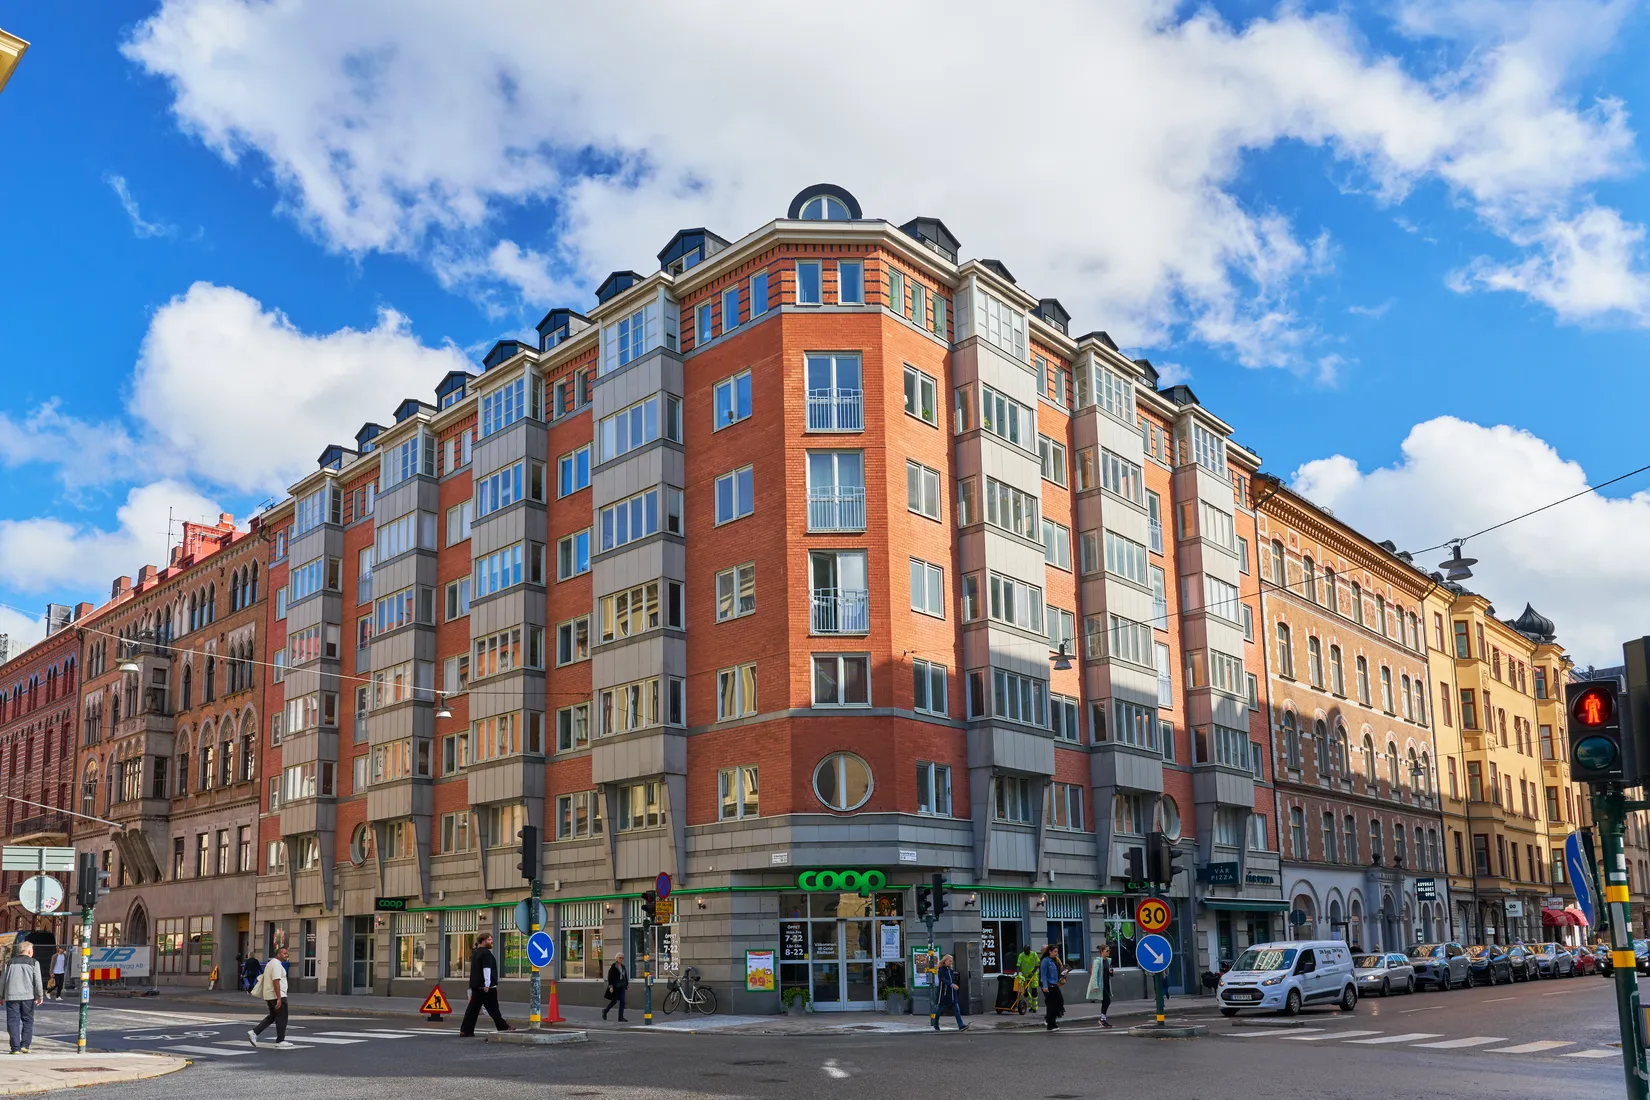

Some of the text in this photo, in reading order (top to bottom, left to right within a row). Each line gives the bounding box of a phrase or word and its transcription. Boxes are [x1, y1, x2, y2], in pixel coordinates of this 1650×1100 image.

[1214, 866, 1230, 874] VÅR
[797, 869, 887, 897] coop
[379, 900, 402, 908] coop
[1142, 907, 1166, 925] 30
[784, 934, 804, 942] 7-22
[982, 940, 994, 948] 7-22
[664, 945, 678, 953] 7-22
[785, 948, 804, 956] 8-22
[89, 947, 137, 962] JB
[982, 957, 996, 966] 8-22
[664, 962, 678, 970] 8-22
